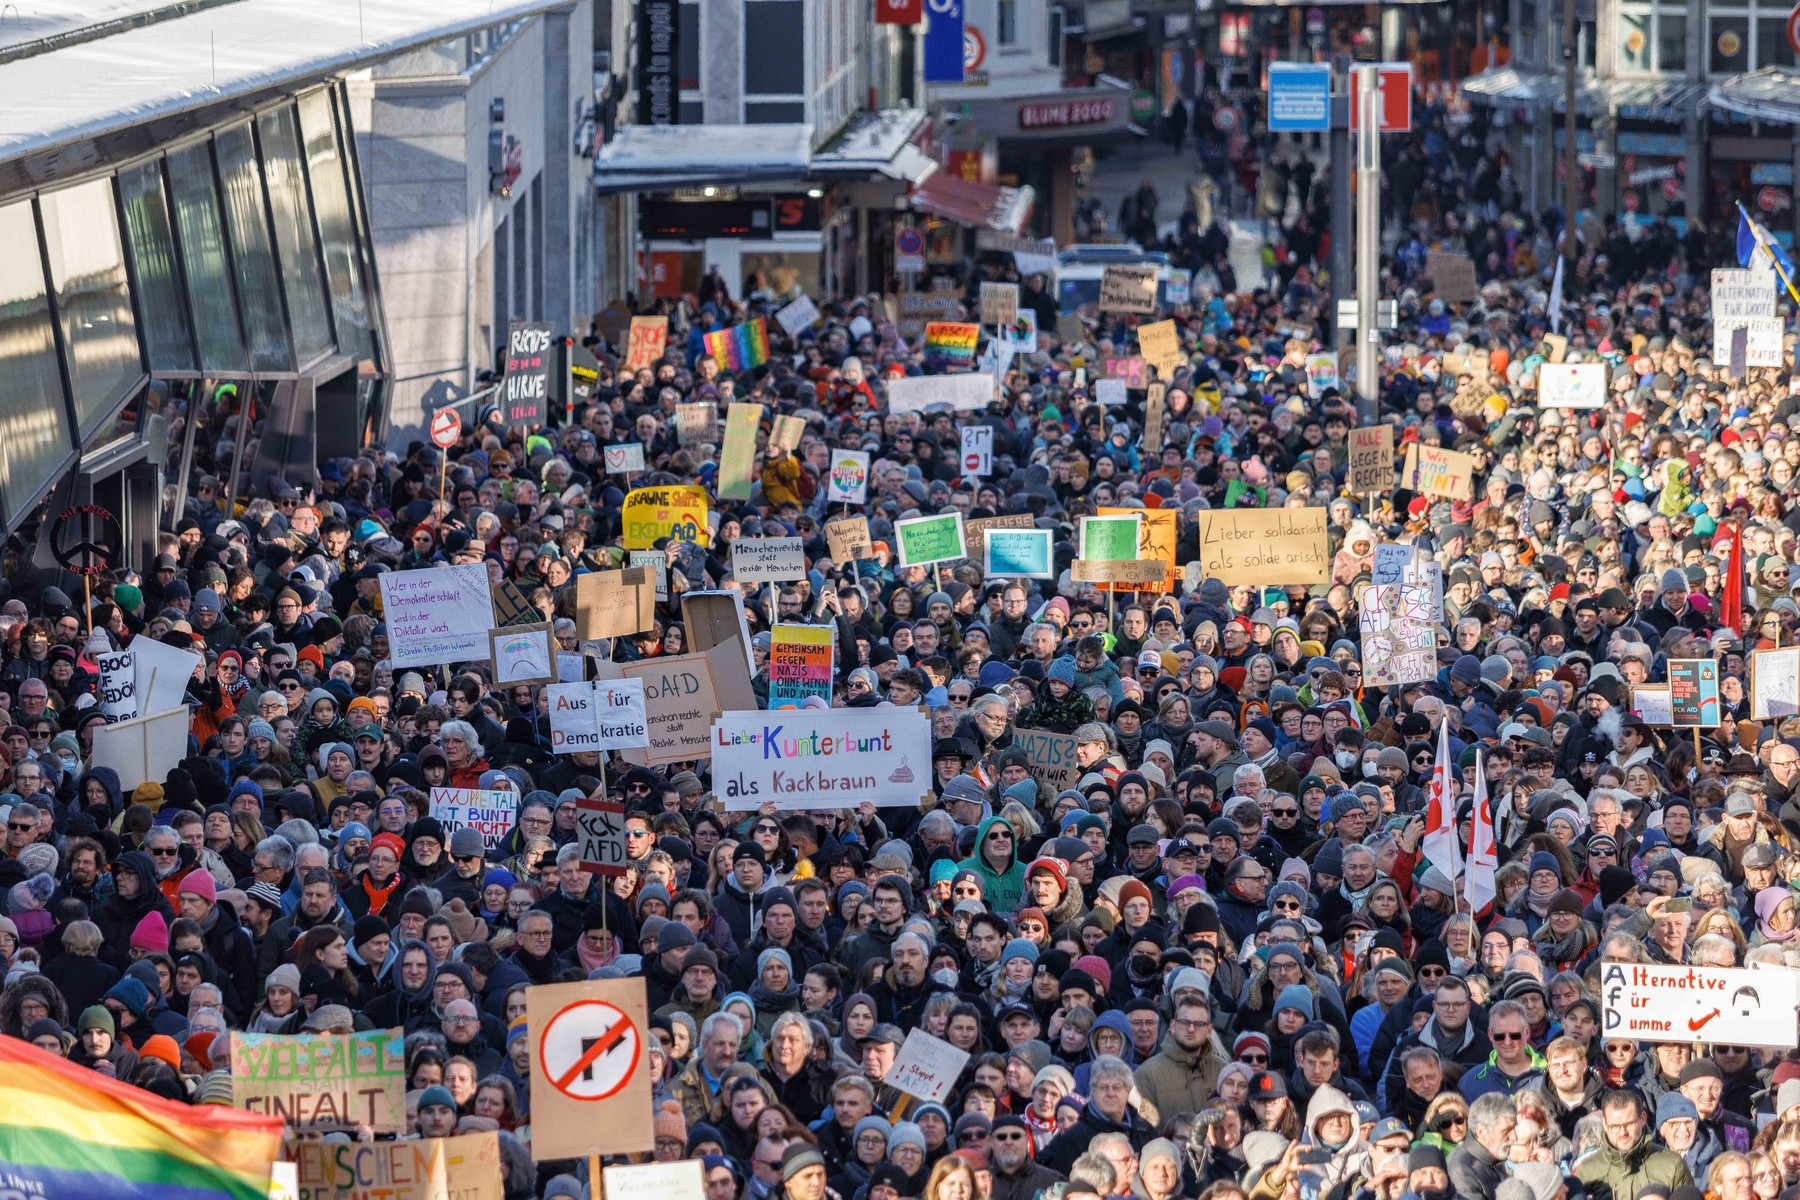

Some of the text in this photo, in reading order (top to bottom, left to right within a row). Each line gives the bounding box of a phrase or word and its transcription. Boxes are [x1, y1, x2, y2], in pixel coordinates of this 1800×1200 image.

[1022, 105, 1068, 126] BLUME
[1070, 101, 1113, 123] 2000
[1106, 358, 1143, 377] FCK
[507, 373, 546, 401] HIRNE
[1355, 429, 1383, 448] ALLE
[1351, 450, 1389, 469] GEGEN
[1426, 448, 1447, 464] Wir
[1418, 460, 1449, 475] sind
[1354, 466, 1395, 489] RECHTS
[1411, 469, 1462, 494] BUNT
[627, 491, 670, 508] BRAUNE
[60, 504, 112, 521] NIE WIEDER
[966, 516, 1032, 535] FÜR LIEBE
[1204, 514, 1326, 544] Lieber solidarisch
[735, 542, 803, 554] Menschenrechte
[1209, 542, 1325, 570] als solide arisch
[758, 553, 776, 562] statt
[69, 561, 109, 576] IST JETZT
[739, 562, 803, 574] rechte Menschen
[386, 578, 432, 592] Wer in der
[390, 593, 435, 607] Demokratie
[393, 610, 431, 623] wird in der
[1360, 608, 1391, 632] AFD
[394, 621, 449, 638] Diktatur wach
[776, 655, 806, 665] GEGEN
[777, 665, 808, 676] NAZIS
[661, 673, 700, 699] AfD
[776, 676, 829, 689] OHNE WENN
[557, 690, 631, 711] Aus für
[776, 688, 828, 701] UND ABER!
[646, 708, 703, 726] enschenrechte
[666, 724, 685, 733] statt
[650, 735, 711, 750] Rechte Mensche
[719, 725, 893, 760] Lieber Kunterbunt
[1014, 733, 1077, 768] NAZIS?
[726, 771, 760, 798] als
[1047, 769, 1069, 782] WIR
[432, 788, 517, 809] WUPPERTAL
[434, 805, 512, 823] IST BUNT
[442, 821, 512, 836] ND NICHT
[577, 811, 621, 837] FCK
[583, 838, 623, 862] AFD
[238, 1035, 392, 1081] VIELFALT
[909, 1063, 936, 1082] Stoppt
[246, 1088, 385, 1127] EINFALT
